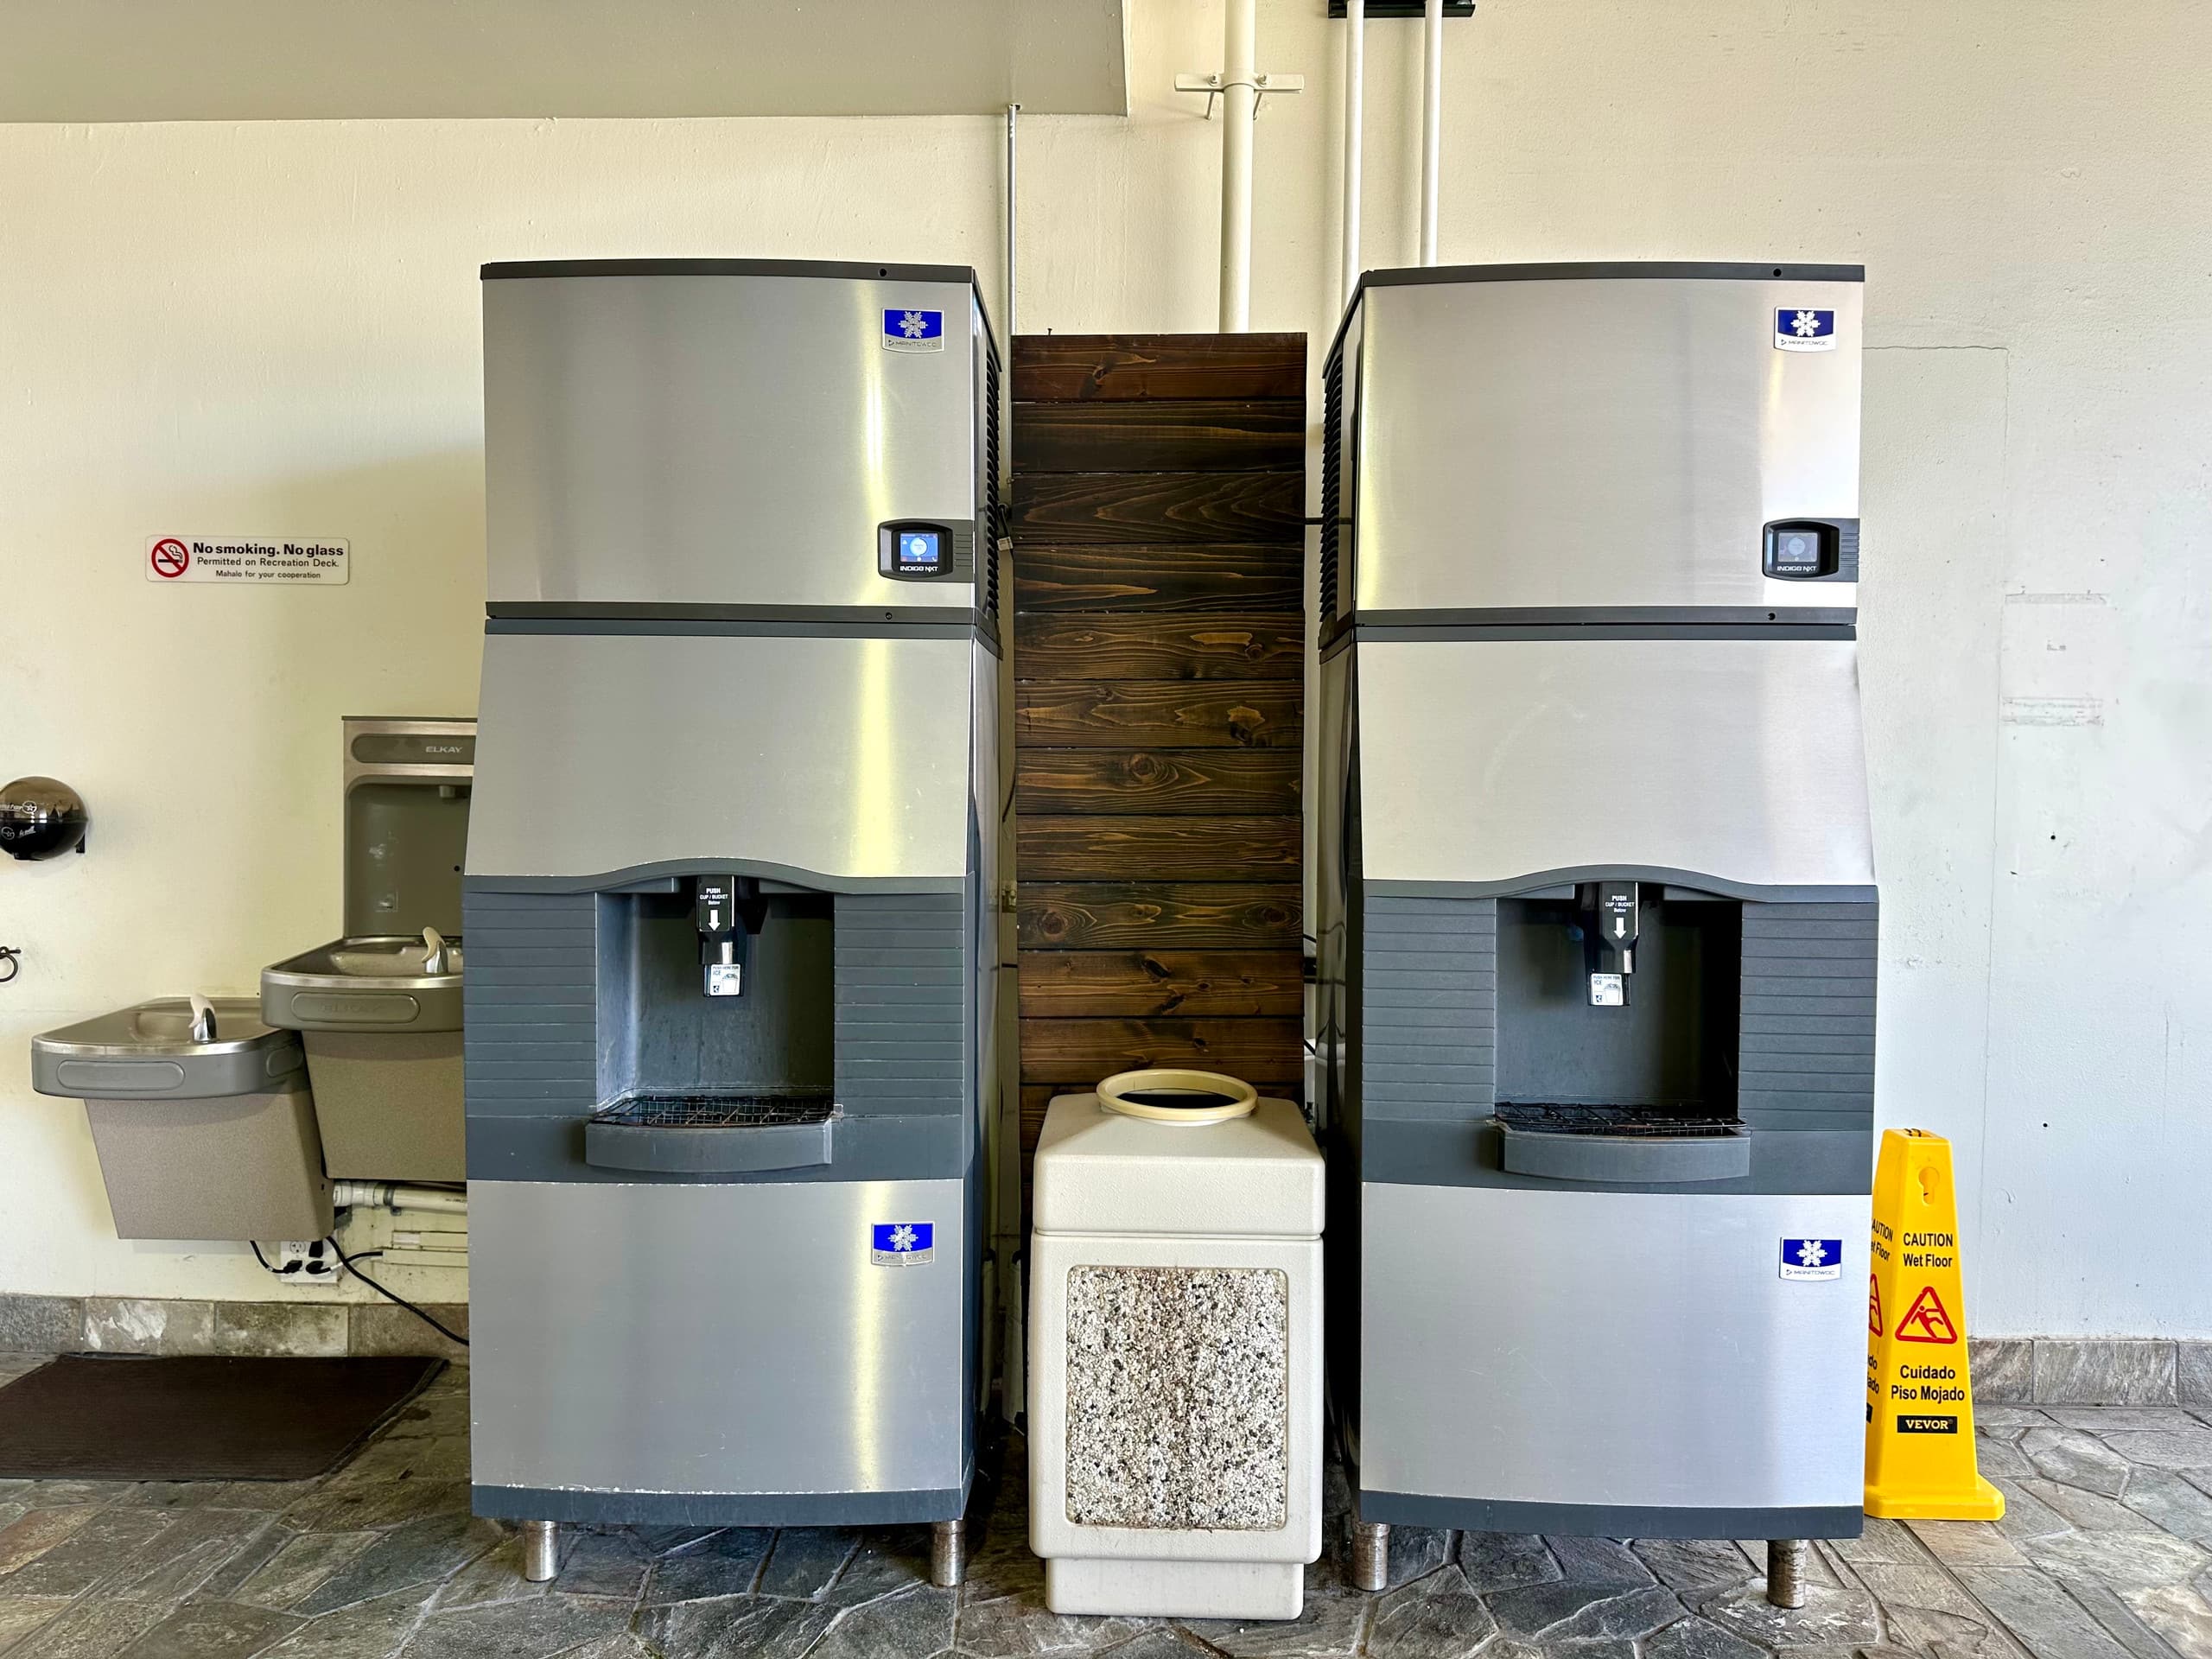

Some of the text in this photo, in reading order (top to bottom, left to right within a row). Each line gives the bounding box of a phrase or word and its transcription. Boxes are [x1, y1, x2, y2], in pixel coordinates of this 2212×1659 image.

[193, 543, 344, 557] No smoking. No glass
[197, 556, 241, 566] Permitted
[260, 557, 309, 567] Recreation
[313, 558, 340, 568] Deck.
[216, 569, 242, 578] Mahalo
[258, 571, 275, 580] your
[277, 571, 321, 580] cooperation
[1872, 1218, 1893, 1242] AUTION
[1903, 1233, 1953, 1247] CAUTION
[1875, 1242, 1891, 1262] Floor
[1903, 1253, 1953, 1268] Wet Floor
[1900, 1364, 1956, 1380] Cuidado
[1891, 1384, 1965, 1404] Piso Mojado
[1905, 1419, 1949, 1430] VEVOR
